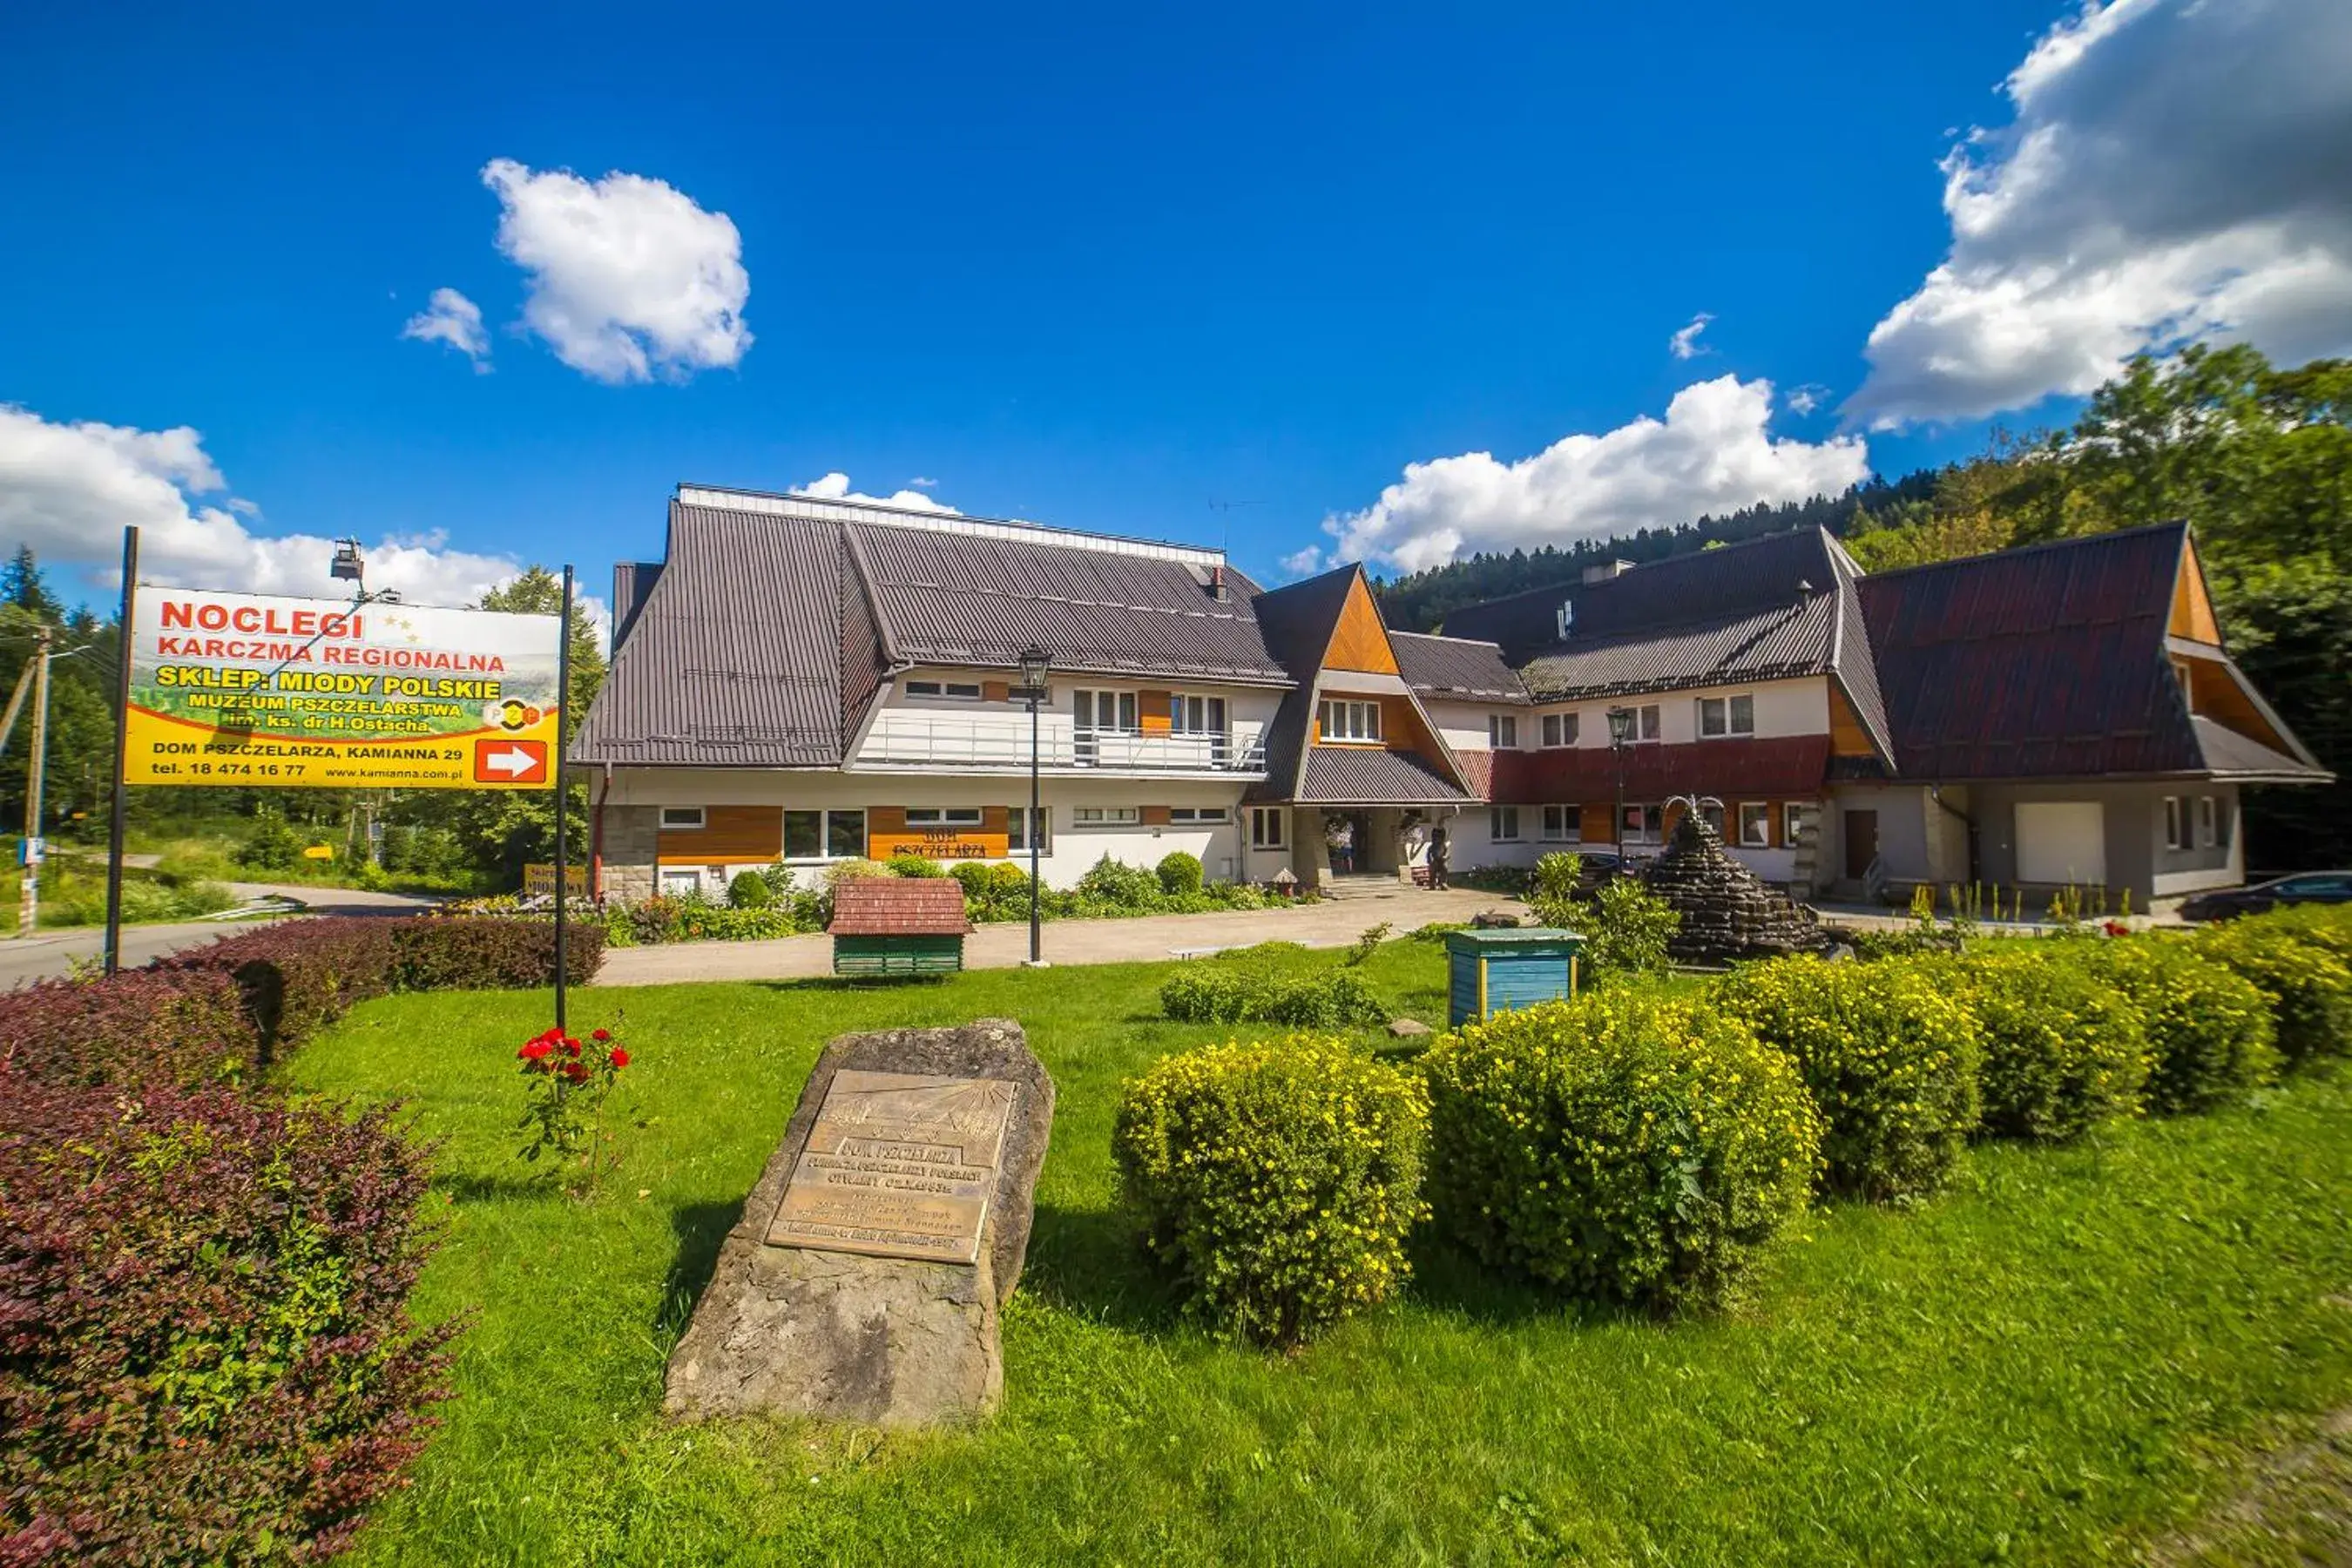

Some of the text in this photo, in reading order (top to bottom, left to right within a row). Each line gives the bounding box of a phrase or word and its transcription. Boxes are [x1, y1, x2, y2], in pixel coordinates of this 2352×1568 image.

[161, 601, 362, 638] NOCLEGI
[158, 637, 505, 672] KARCZMA REGIONALNA
[156, 666, 501, 700] SKLEP: MIODY POLSKIE
[188, 693, 463, 718] MUZEUM PSZCZELARSTWA
[267, 714, 296, 728] ks.
[303, 715, 325, 729] dr
[153, 743, 463, 760] DOM PSZCZELARZA, KAMIANNA 29
[152, 762, 307, 776] tel. 18 474 16 77
[326, 767, 463, 780] www.kamianna.com.pl
